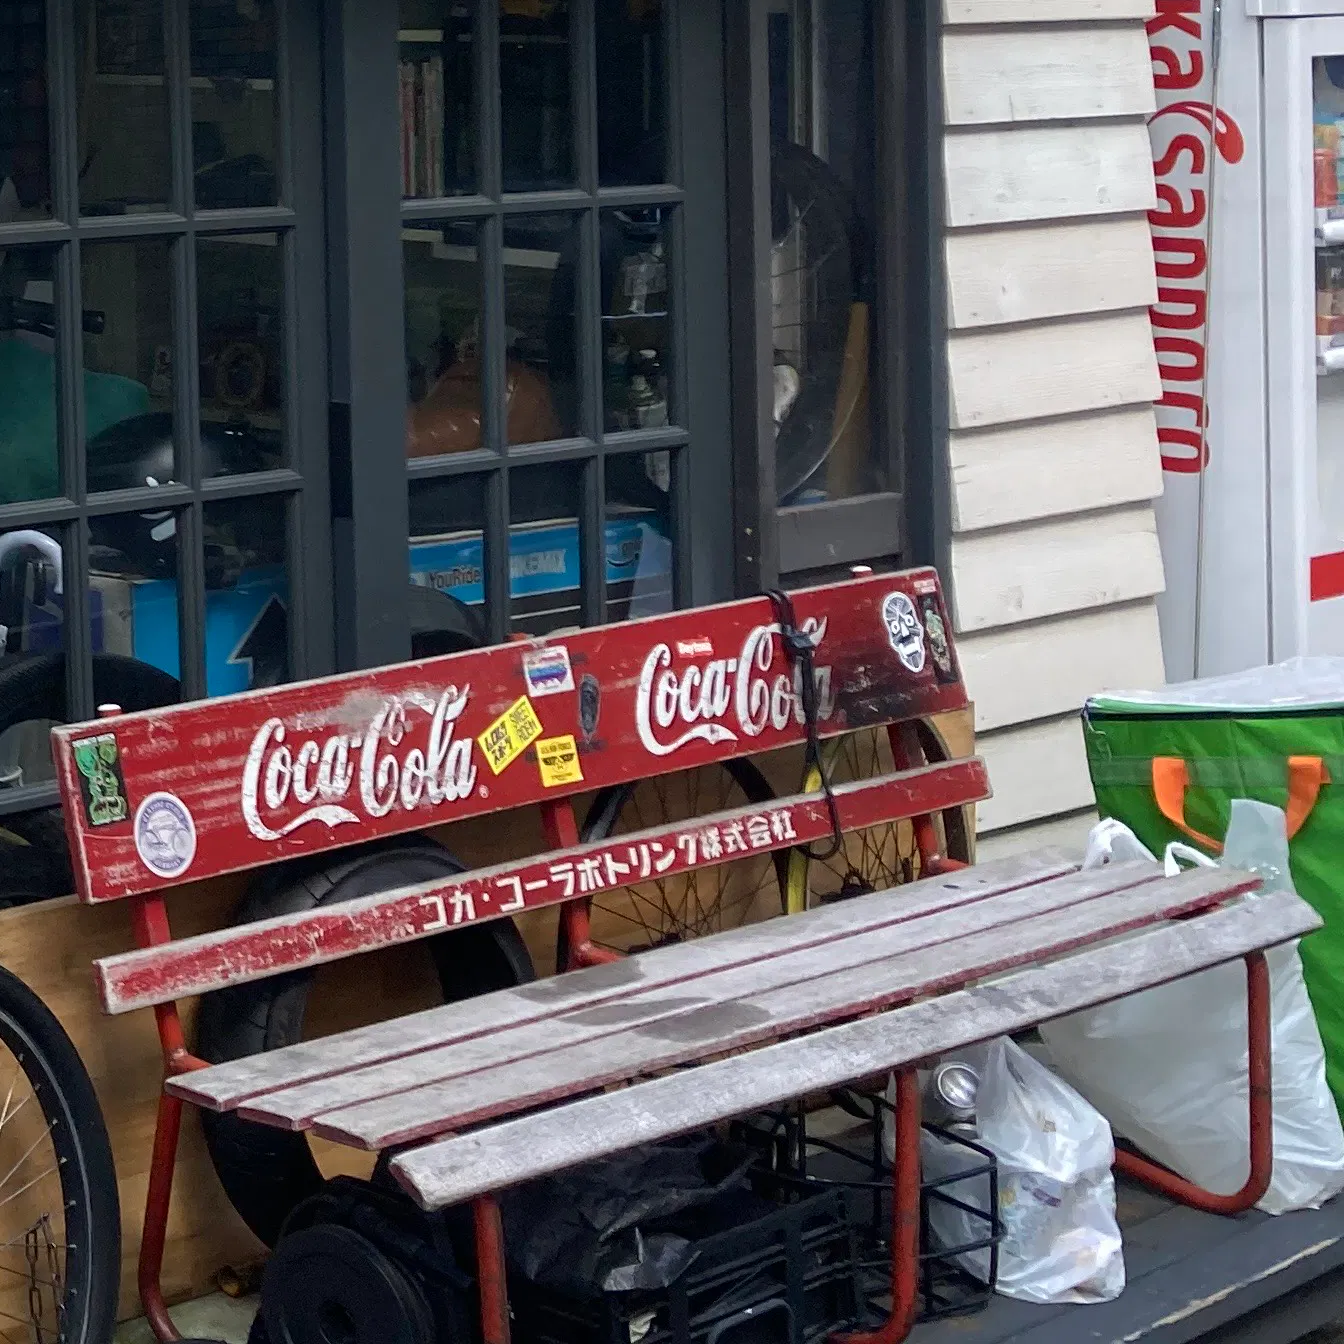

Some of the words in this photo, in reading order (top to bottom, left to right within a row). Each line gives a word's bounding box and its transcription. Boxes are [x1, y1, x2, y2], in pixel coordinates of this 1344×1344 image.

[241, 683, 478, 841] Coca-Cola
[419, 810, 796, 930] コカ・コーラボトリング株式会社
